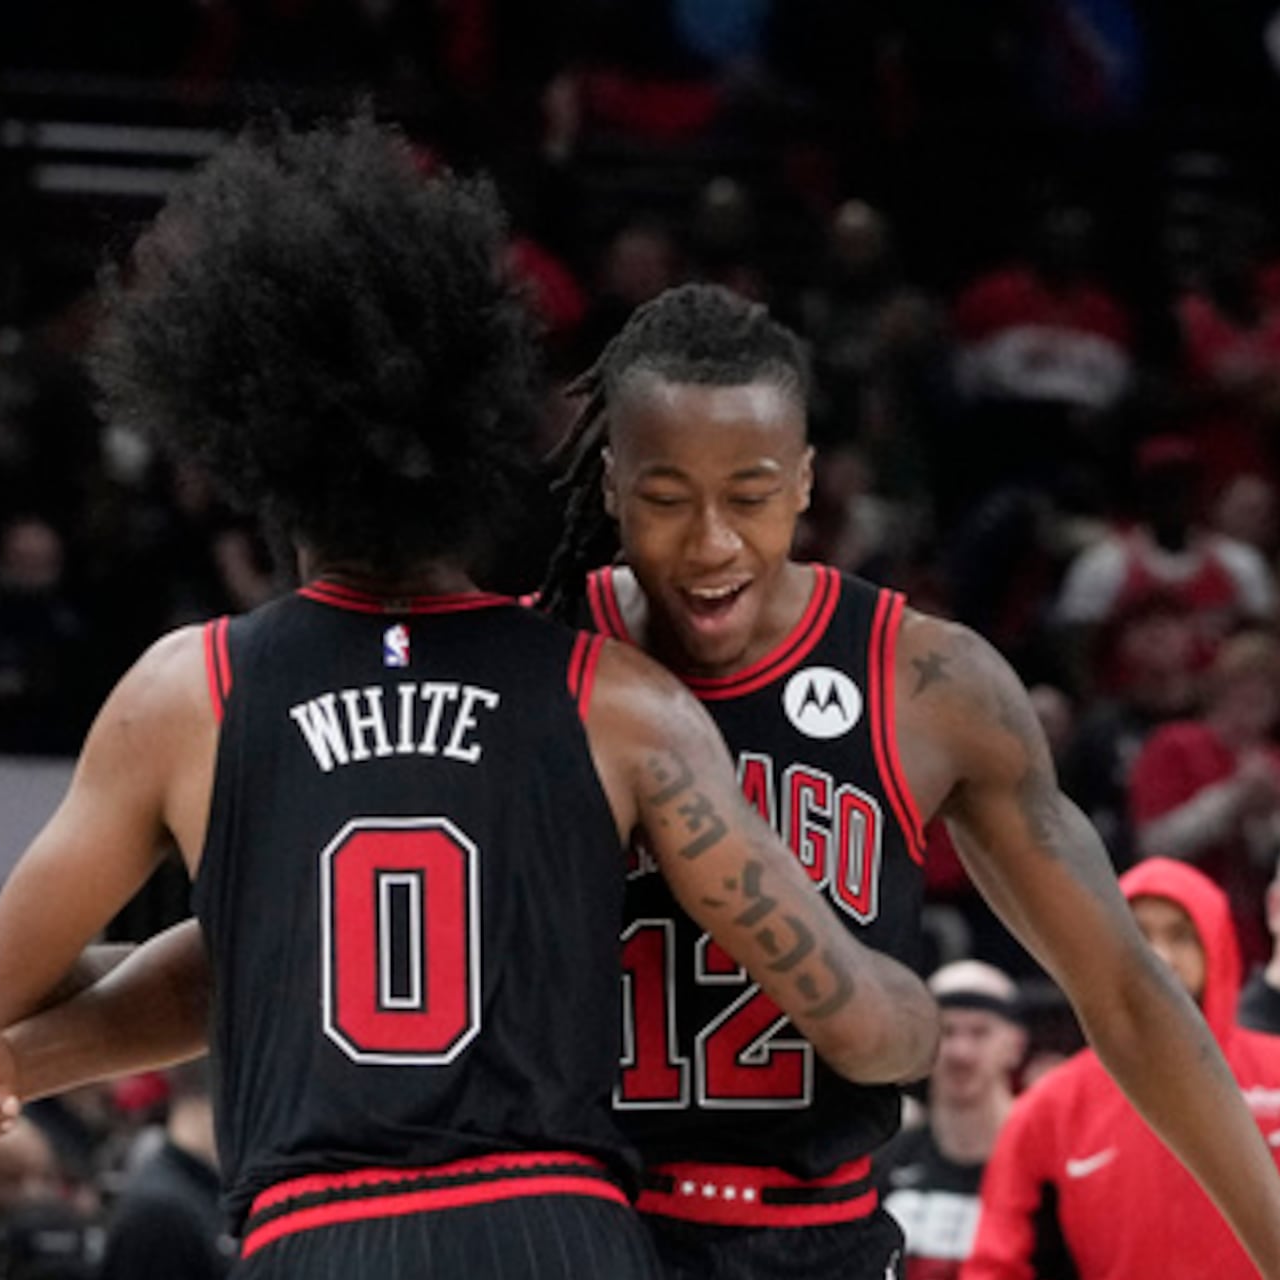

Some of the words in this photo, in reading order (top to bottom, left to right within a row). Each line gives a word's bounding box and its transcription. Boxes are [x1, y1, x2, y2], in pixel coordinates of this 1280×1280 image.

[290, 682, 500, 772] WHITE
[321, 816, 480, 1065] 0
[613, 917, 813, 1110] 12
